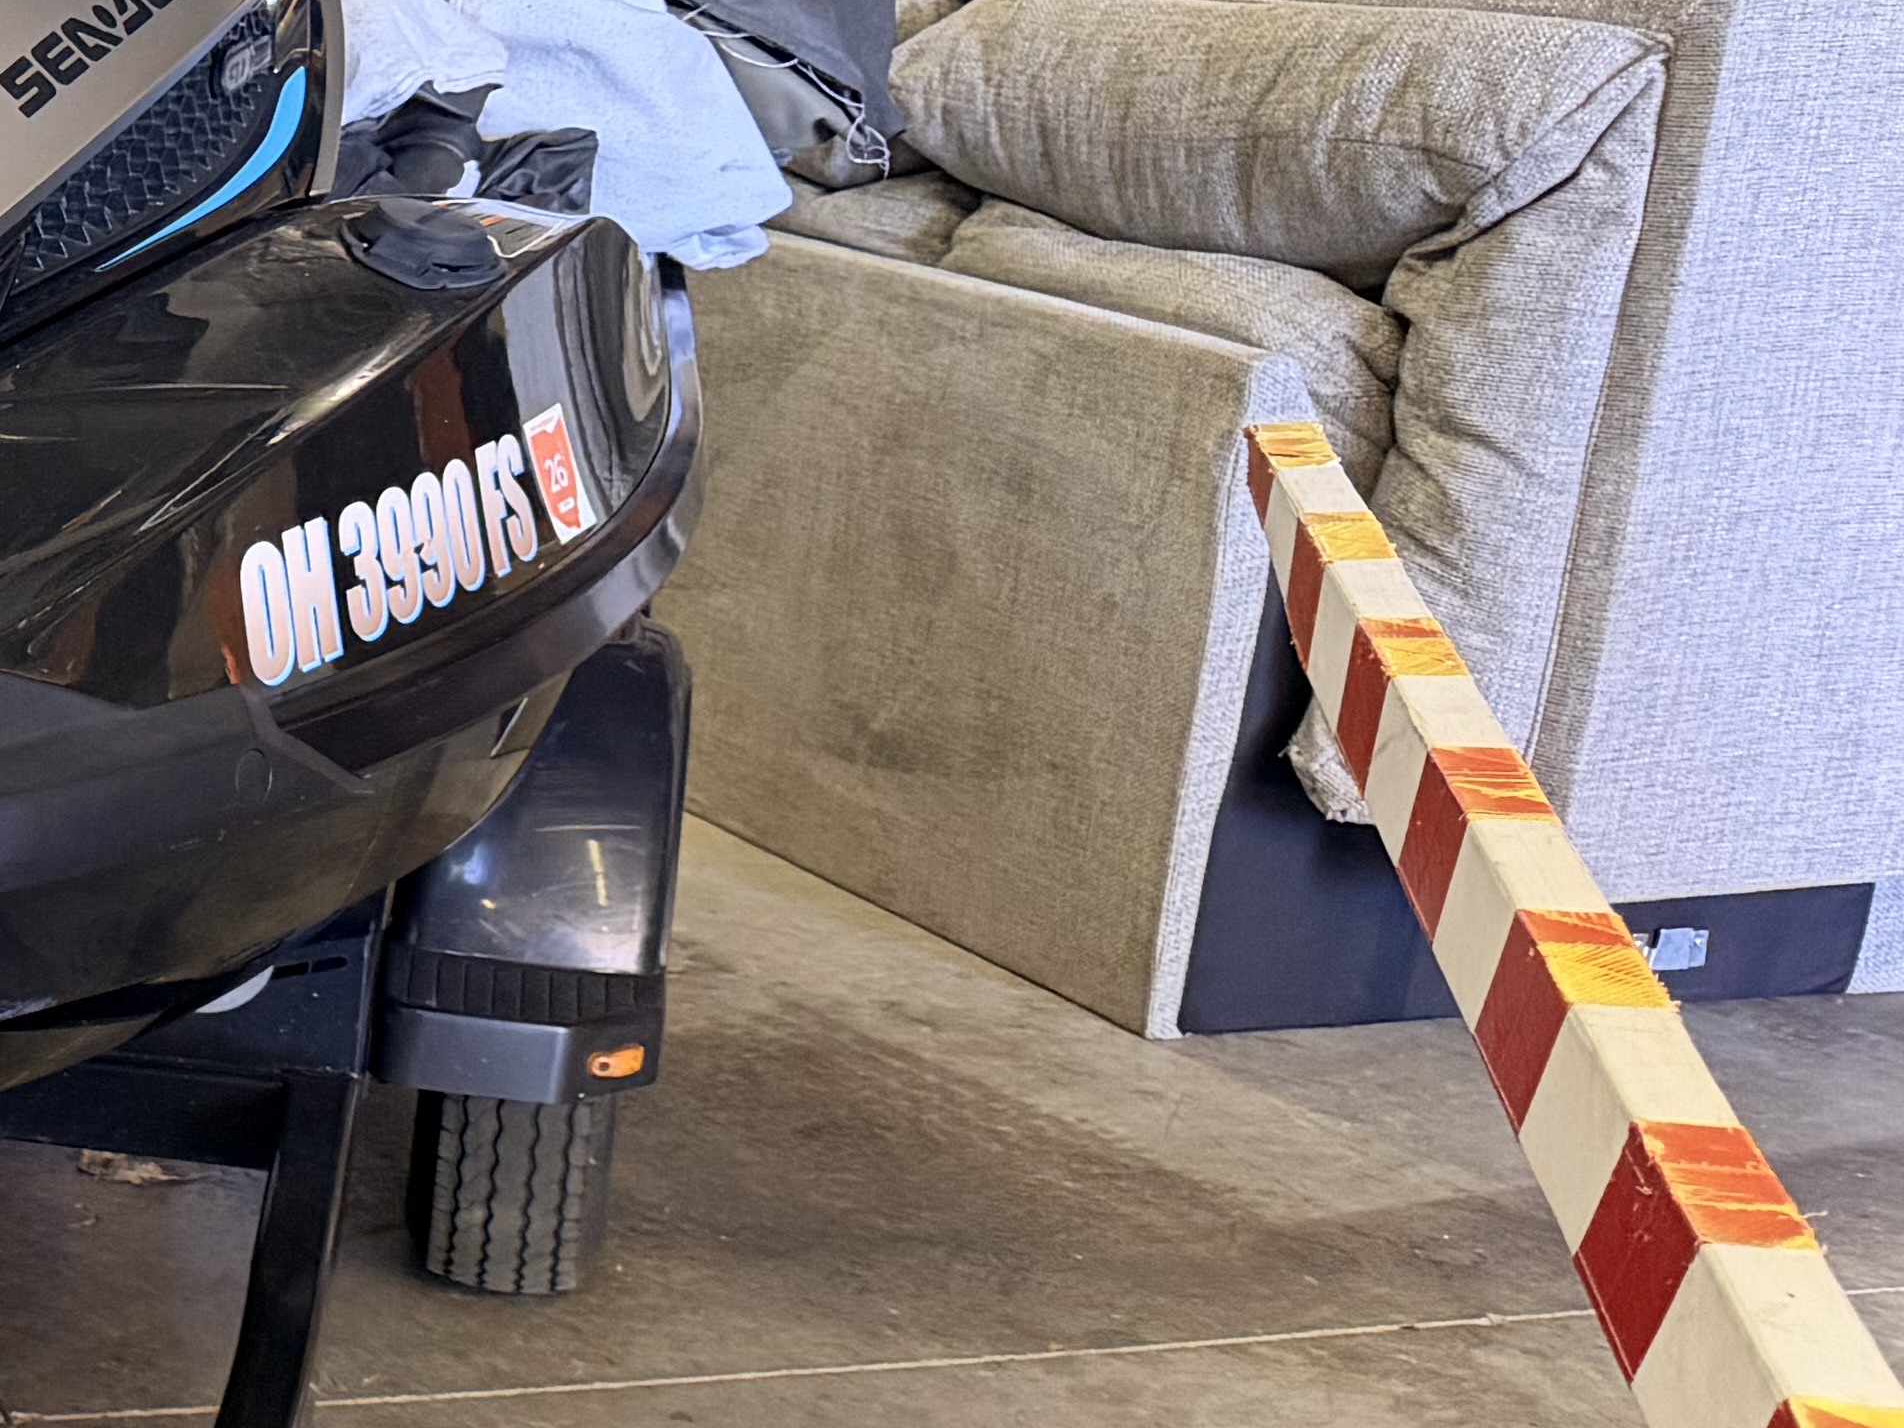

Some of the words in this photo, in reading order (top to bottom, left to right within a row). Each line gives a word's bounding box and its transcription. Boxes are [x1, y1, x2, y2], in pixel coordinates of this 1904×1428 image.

[543, 457, 569, 492] 26
[239, 515, 345, 687] OH
[338, 458, 485, 643] 3990
[474, 433, 538, 579] FS
